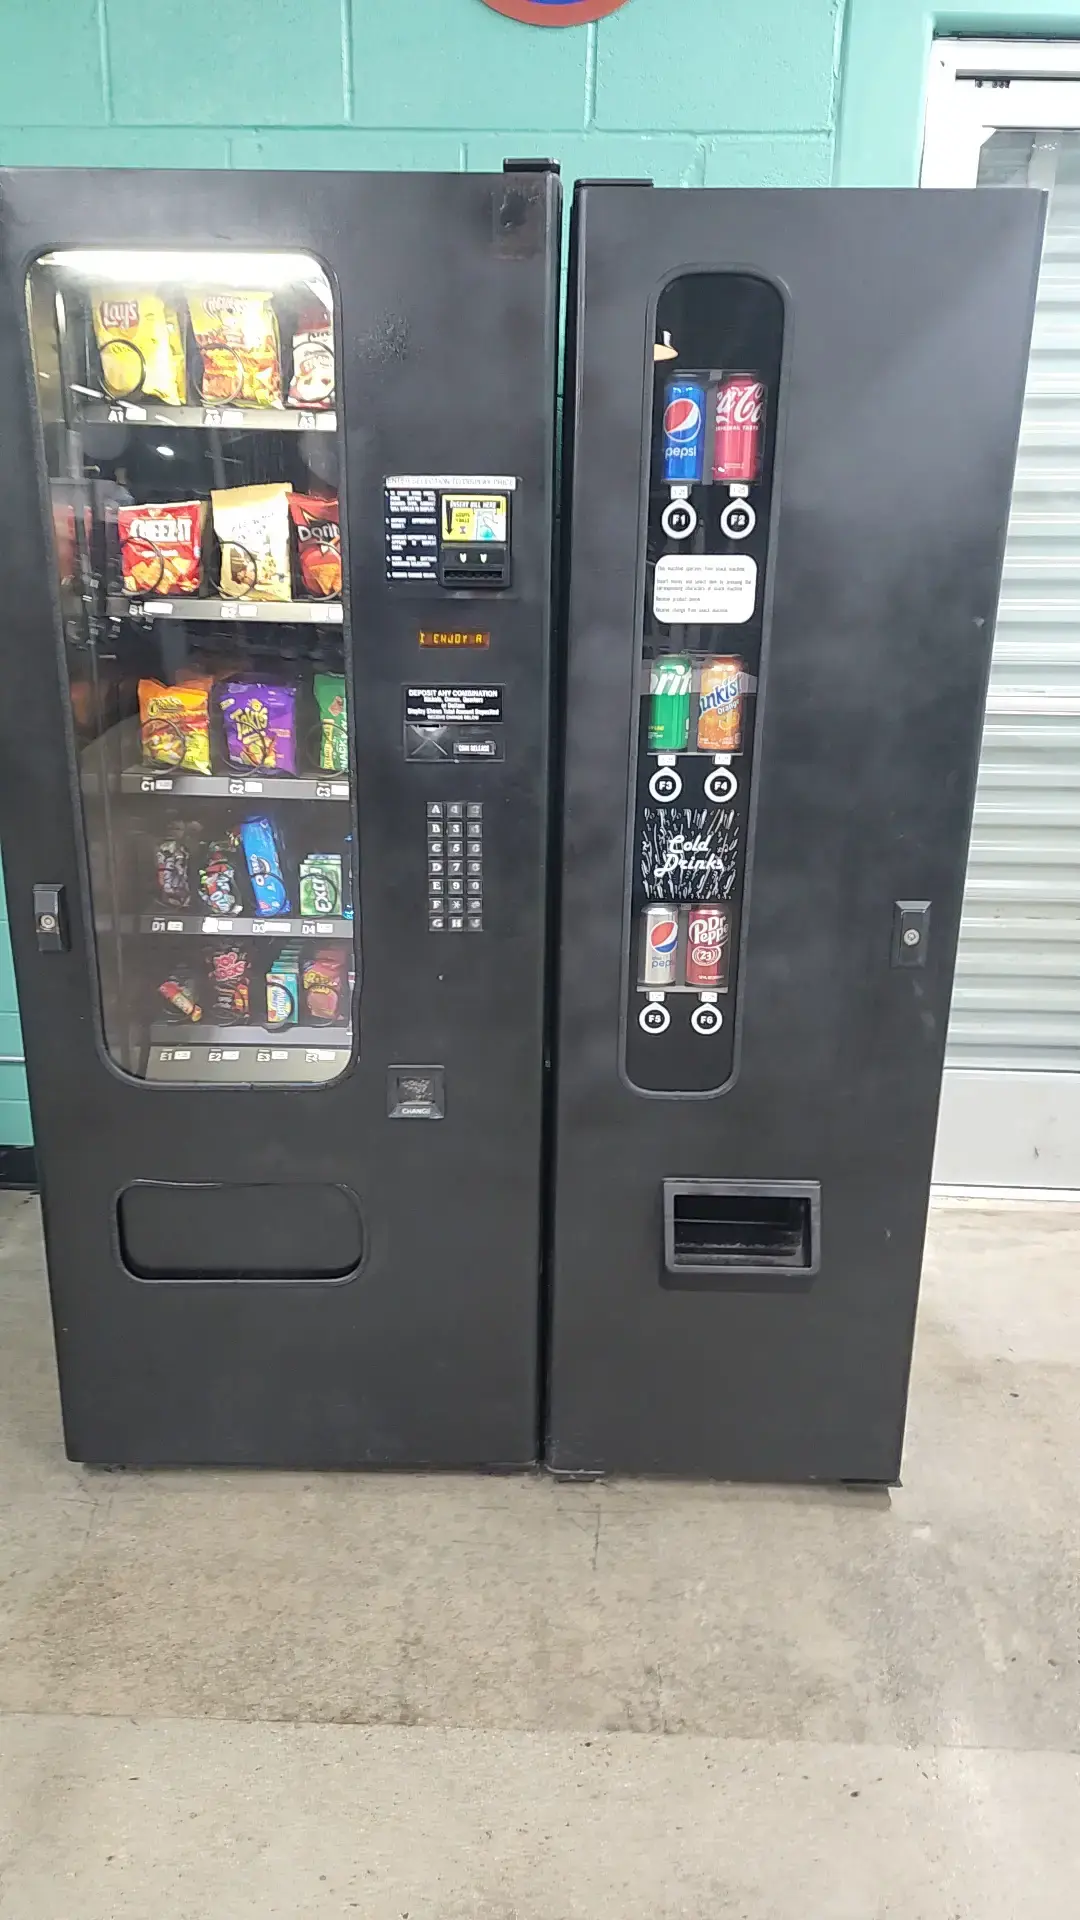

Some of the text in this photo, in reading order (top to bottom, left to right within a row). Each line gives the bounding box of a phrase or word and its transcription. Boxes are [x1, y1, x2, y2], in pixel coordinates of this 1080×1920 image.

[665, 446, 696, 459] pepsi
[672, 514, 686, 525] F1
[730, 514, 746, 526] F2
[433, 633, 468, 645] ENJOY
[475, 633, 483, 644] A
[408, 689, 437, 697] DEPOSIT
[141, 781, 155, 792] C1
[659, 781, 673, 790] F3
[714, 781, 729, 791] F4
[316, 787, 331, 797] C3
[668, 834, 712, 854] Cold
[653, 853, 725, 878] Drinks
[151, 921, 166, 932] D1
[707, 916, 726, 931] Dr
[302, 924, 316, 935] D4
[689, 919, 729, 946] Peppe
[700, 951, 712, 961] 23
[648, 1014, 662, 1024] F5
[700, 1015, 714, 1025] F6
[160, 1052, 172, 1061] E1
[208, 1052, 221, 1062] E2
